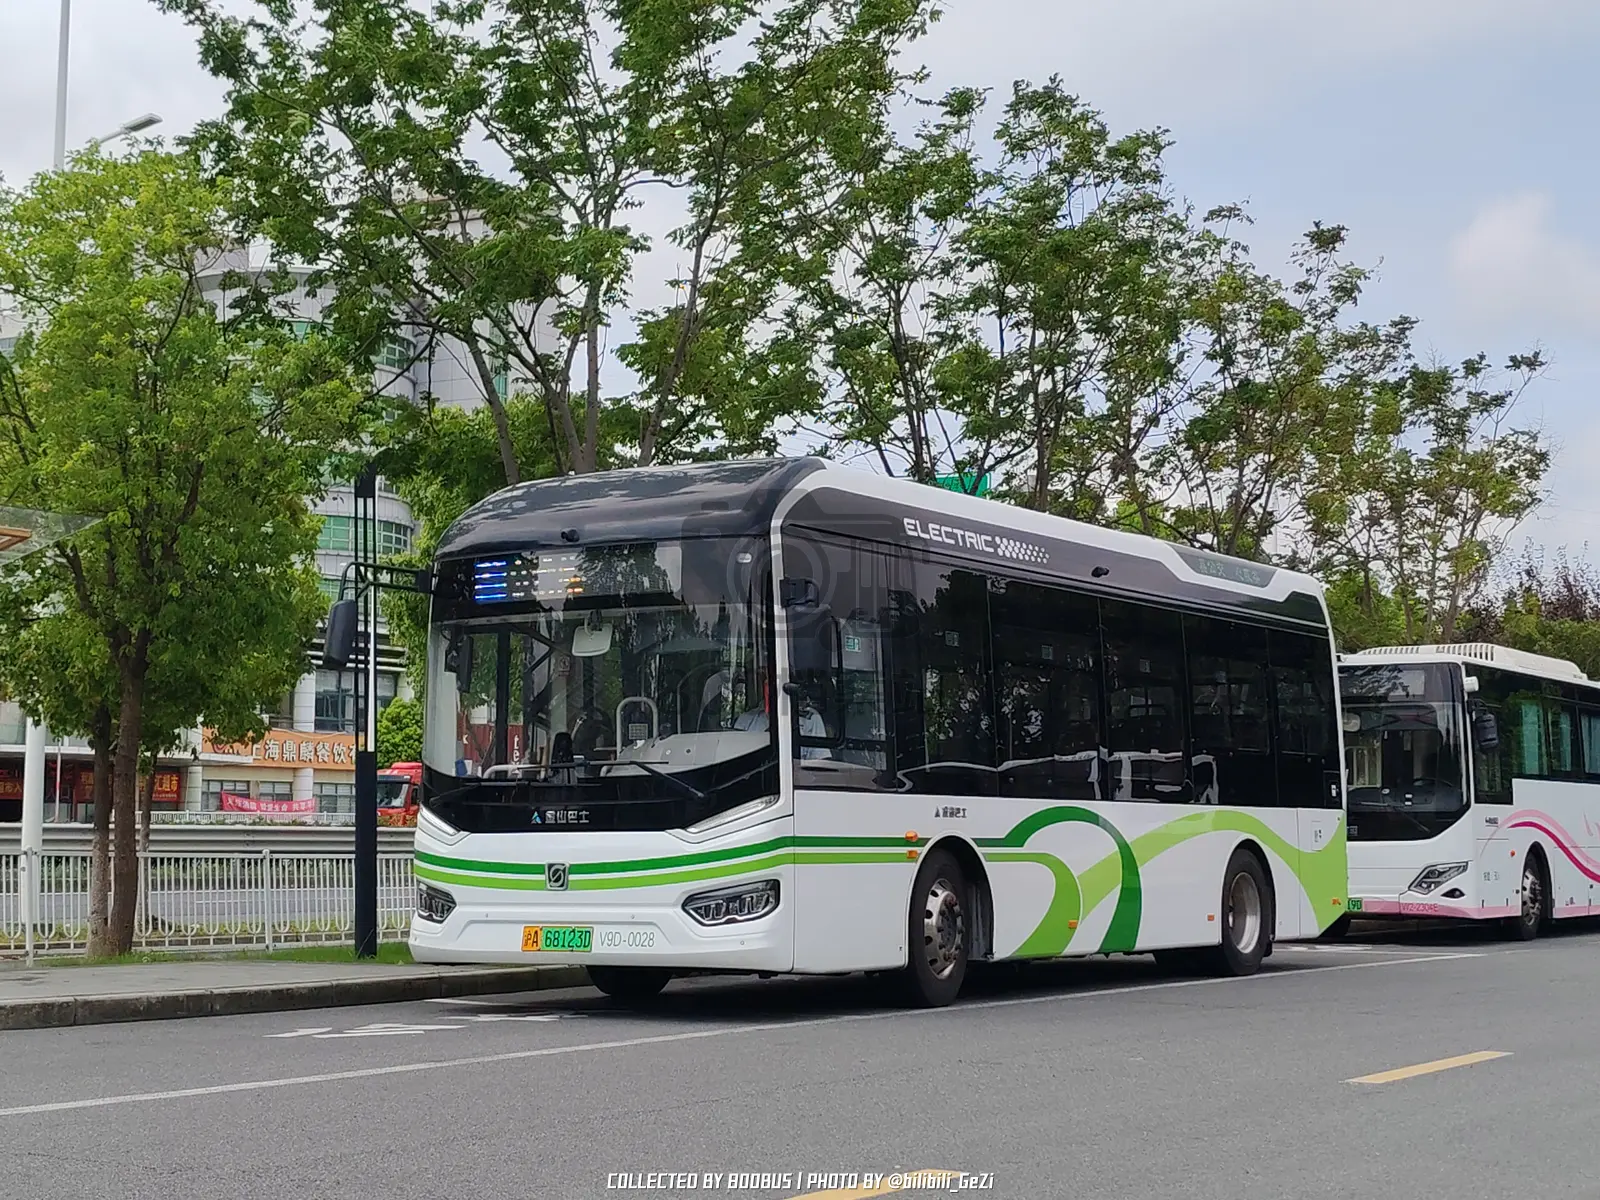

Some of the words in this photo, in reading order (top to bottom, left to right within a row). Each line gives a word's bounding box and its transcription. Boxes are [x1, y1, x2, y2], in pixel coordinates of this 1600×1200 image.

[903, 517, 995, 553] ELECTRIC
[545, 810, 590, 824] 金山巴士
[600, 931, 655, 948] V9D-0028
